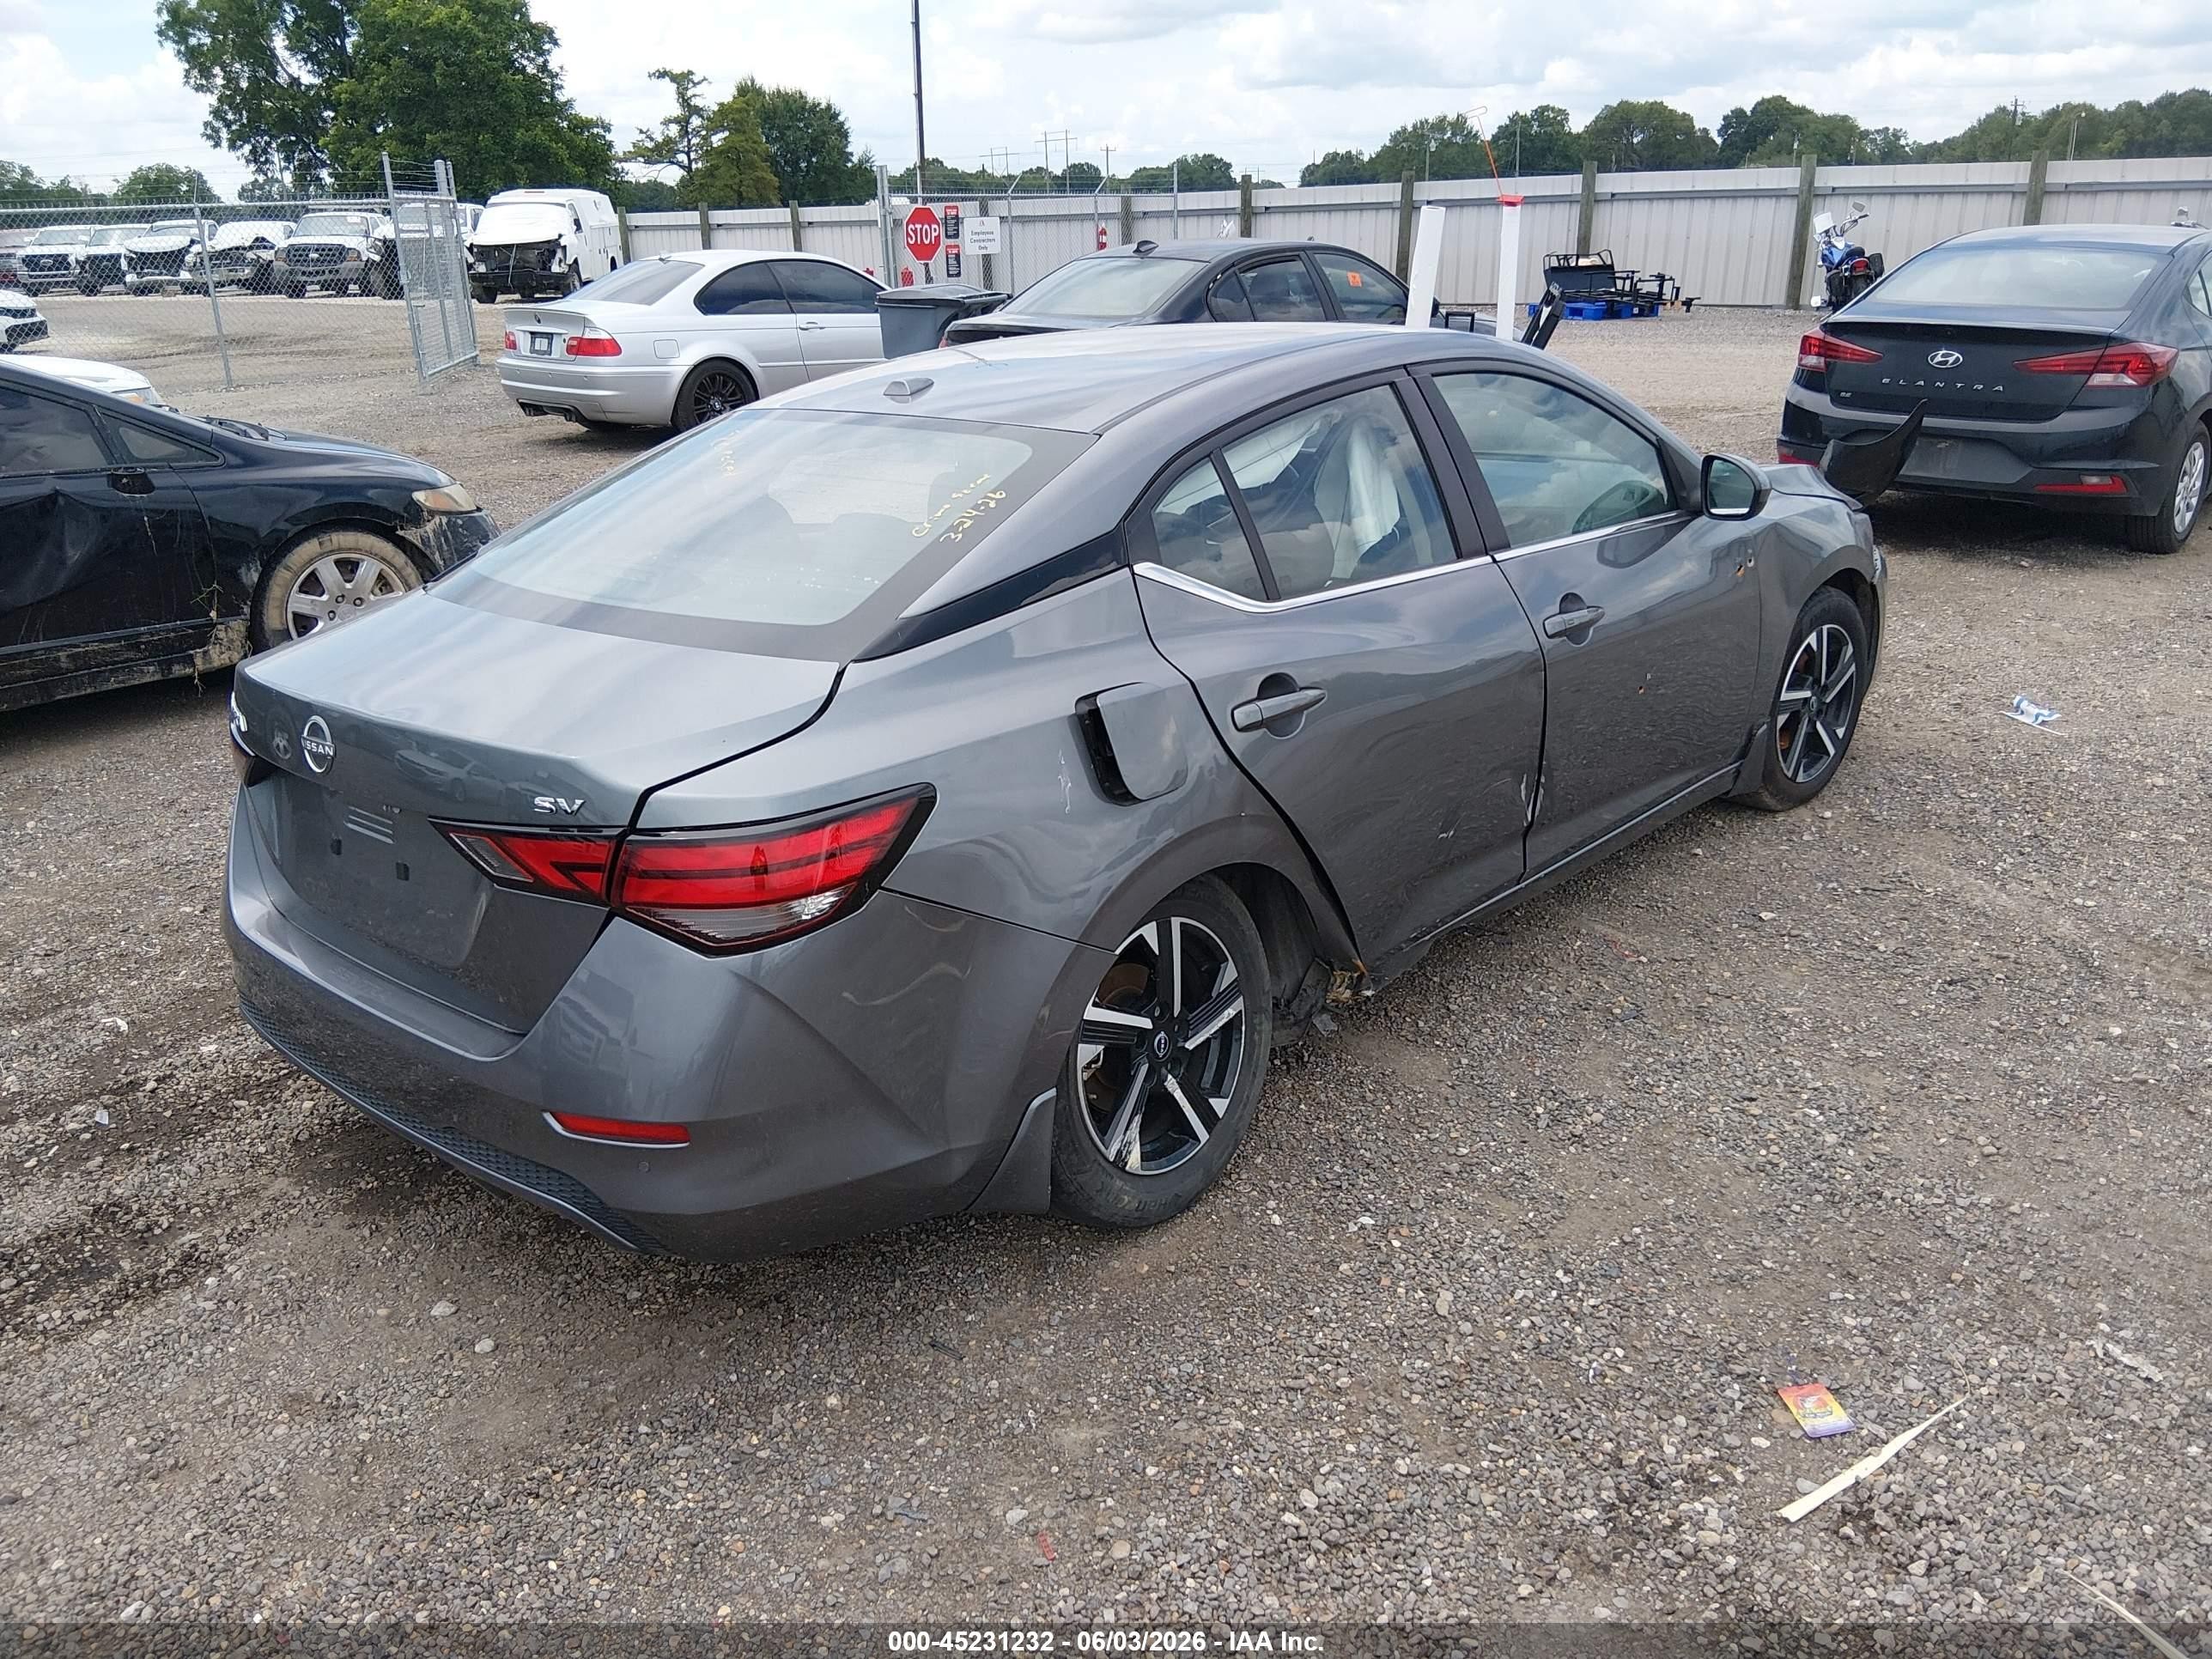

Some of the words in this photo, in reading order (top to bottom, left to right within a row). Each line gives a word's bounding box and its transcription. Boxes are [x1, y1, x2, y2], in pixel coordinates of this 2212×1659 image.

[908, 224, 939, 245] STOP
[1881, 378, 2004, 392] ELANTRA
[533, 796, 586, 816] SV
